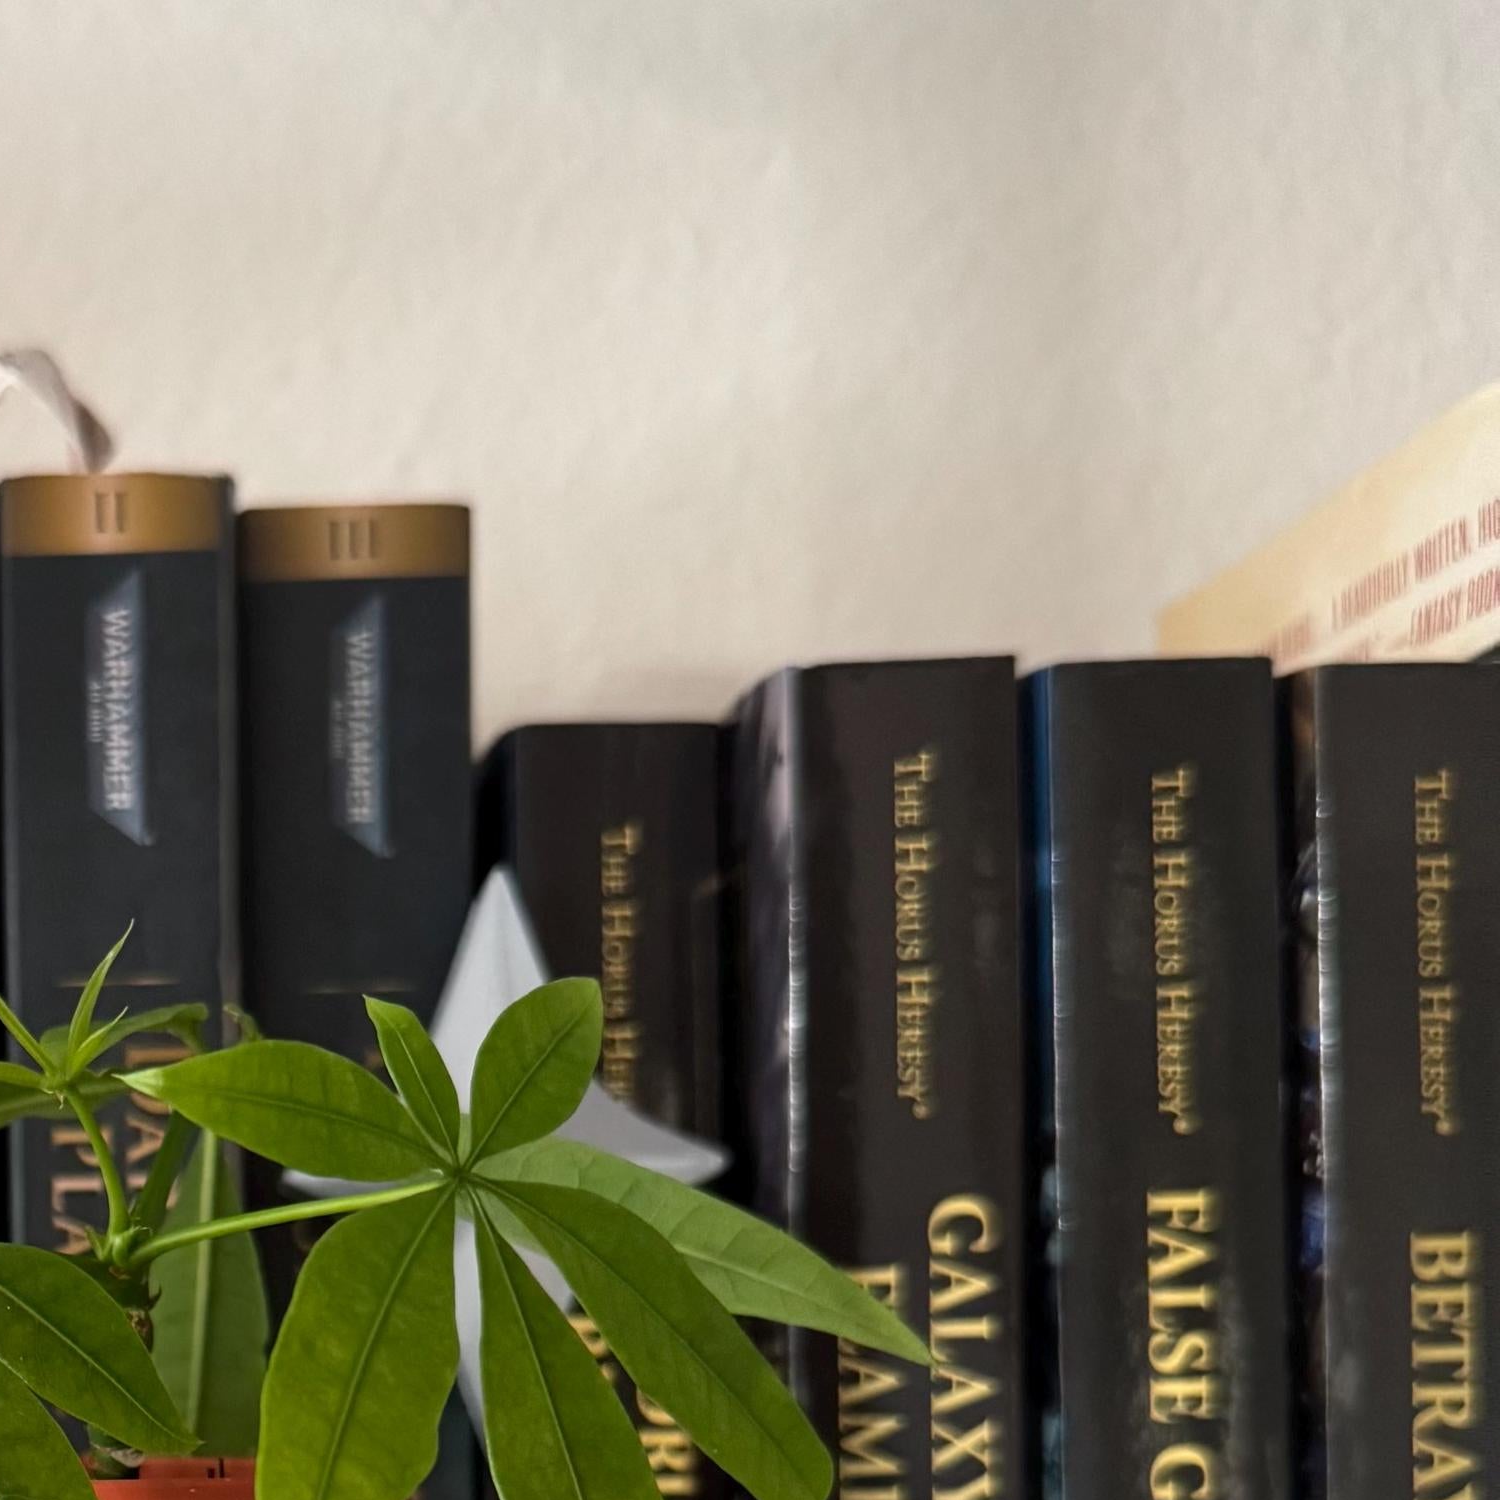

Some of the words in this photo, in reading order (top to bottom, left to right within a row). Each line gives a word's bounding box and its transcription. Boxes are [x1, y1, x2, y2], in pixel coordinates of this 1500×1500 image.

[328, 519, 377, 561] III
[102, 608, 136, 811] WARHAMMER
[345, 630, 374, 823] WARHAMMER
[1146, 1187, 1220, 1424] FALSE
